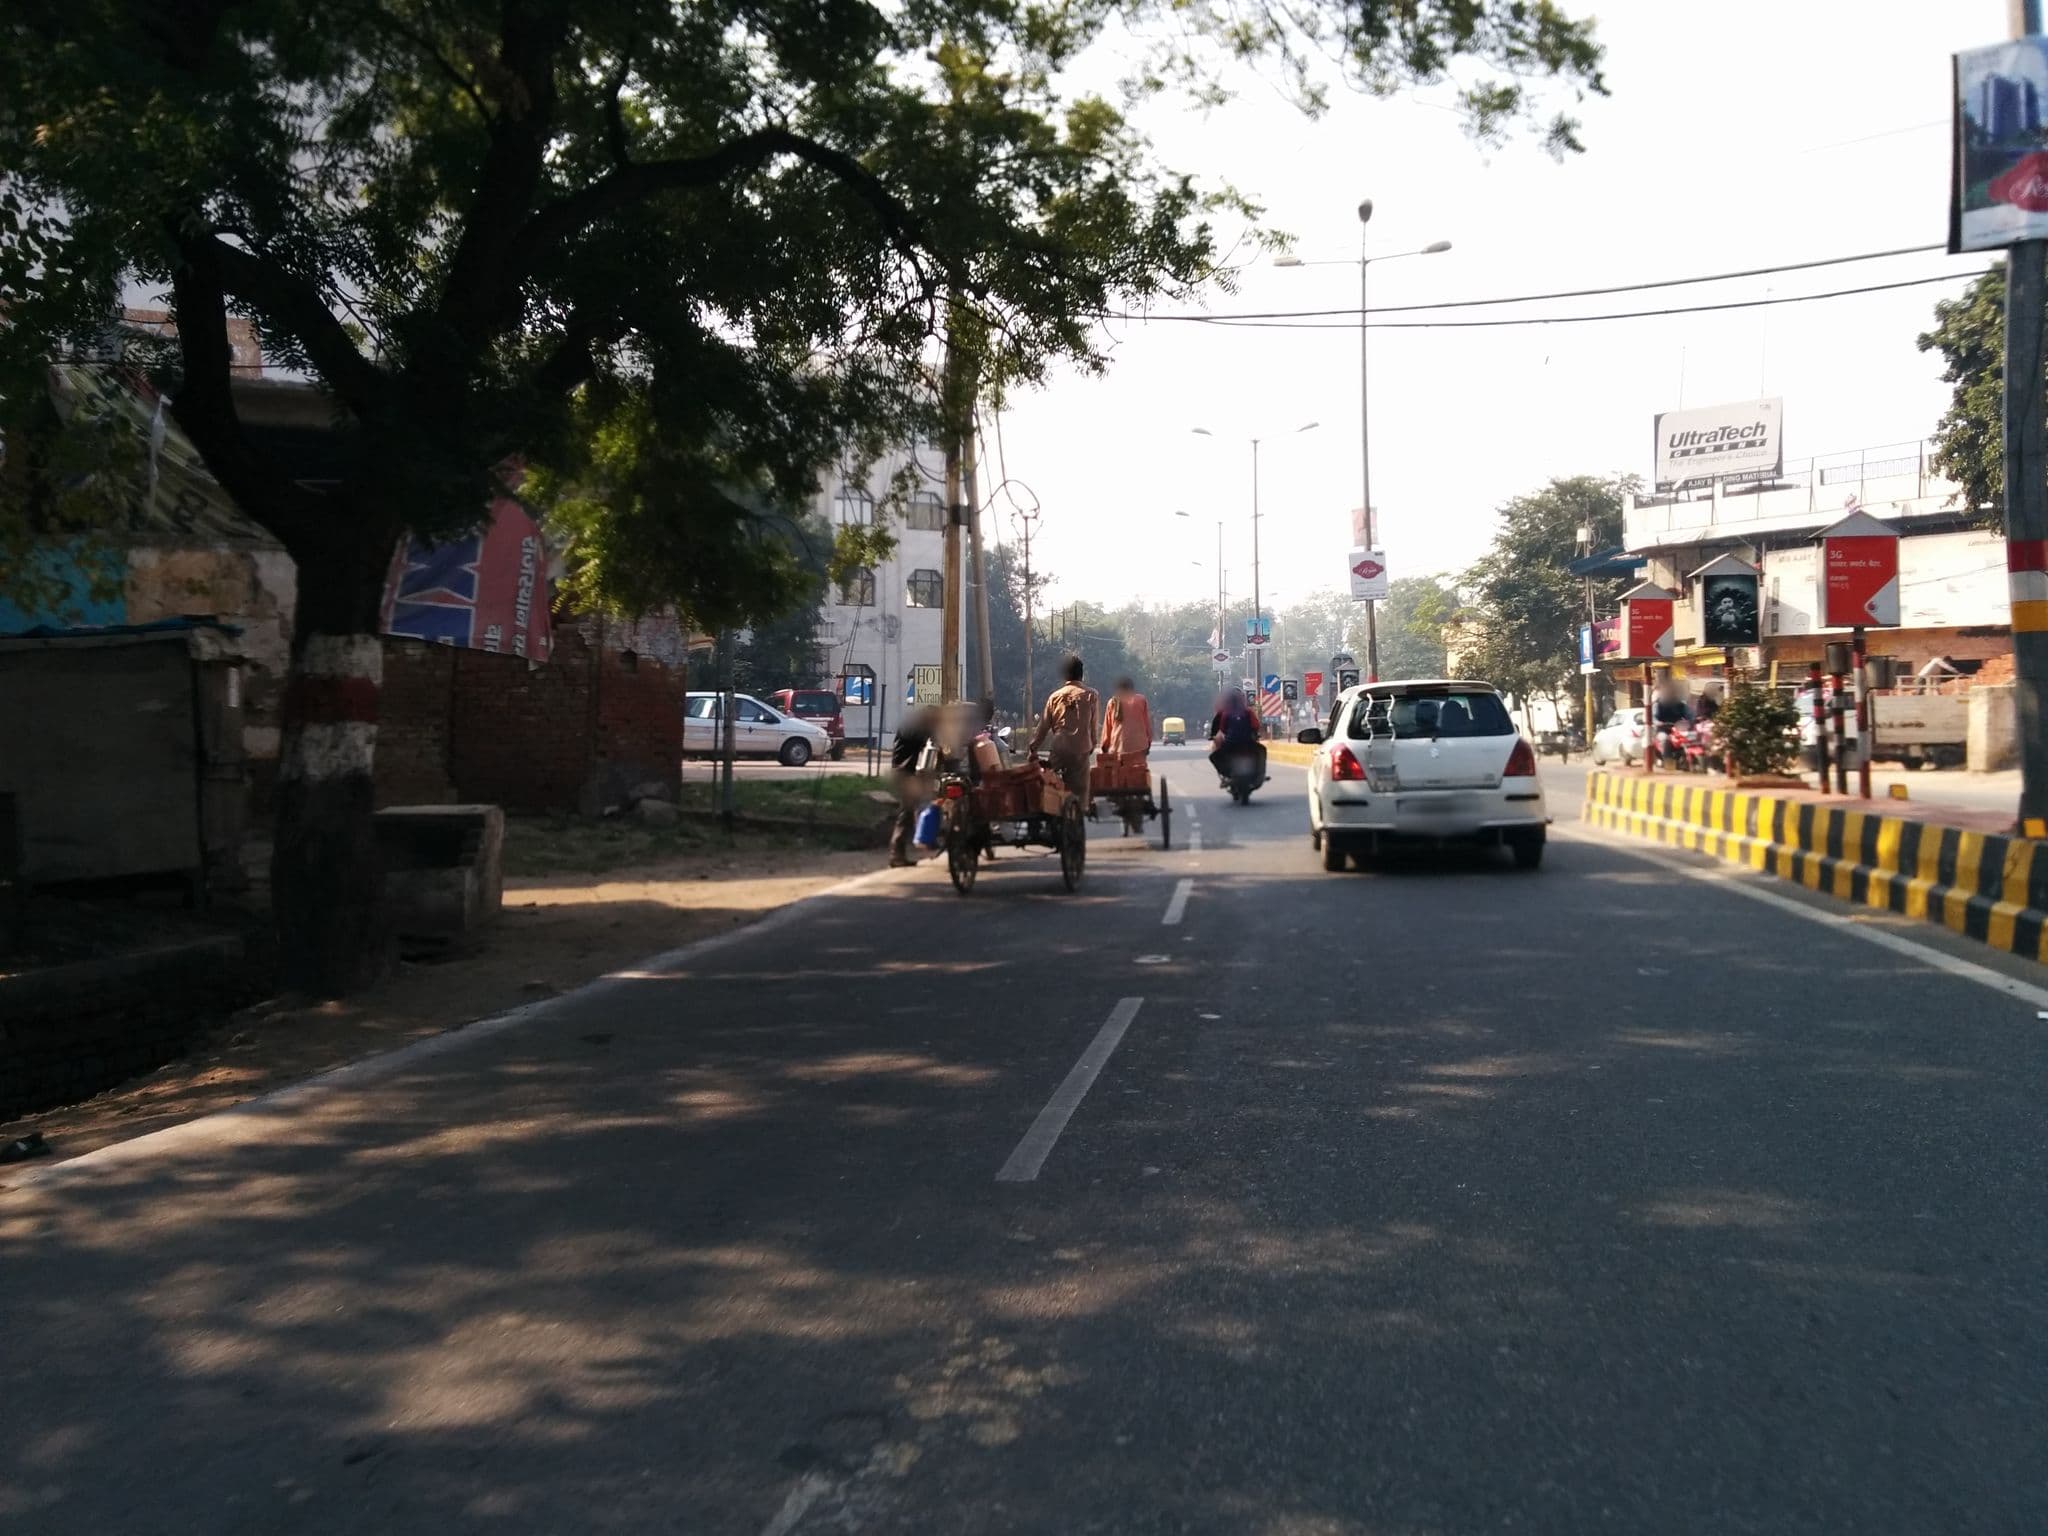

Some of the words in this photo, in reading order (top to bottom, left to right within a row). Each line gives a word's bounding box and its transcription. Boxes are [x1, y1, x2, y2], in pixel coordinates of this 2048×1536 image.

[1669, 421, 1767, 448] UltraTech
[1673, 440, 1764, 458] CEMENT
[1688, 479, 1706, 487] AJAY
[1829, 550, 1843, 559] 3G
[916, 667, 942, 685] HOT
[916, 688, 942, 704] Kiran
